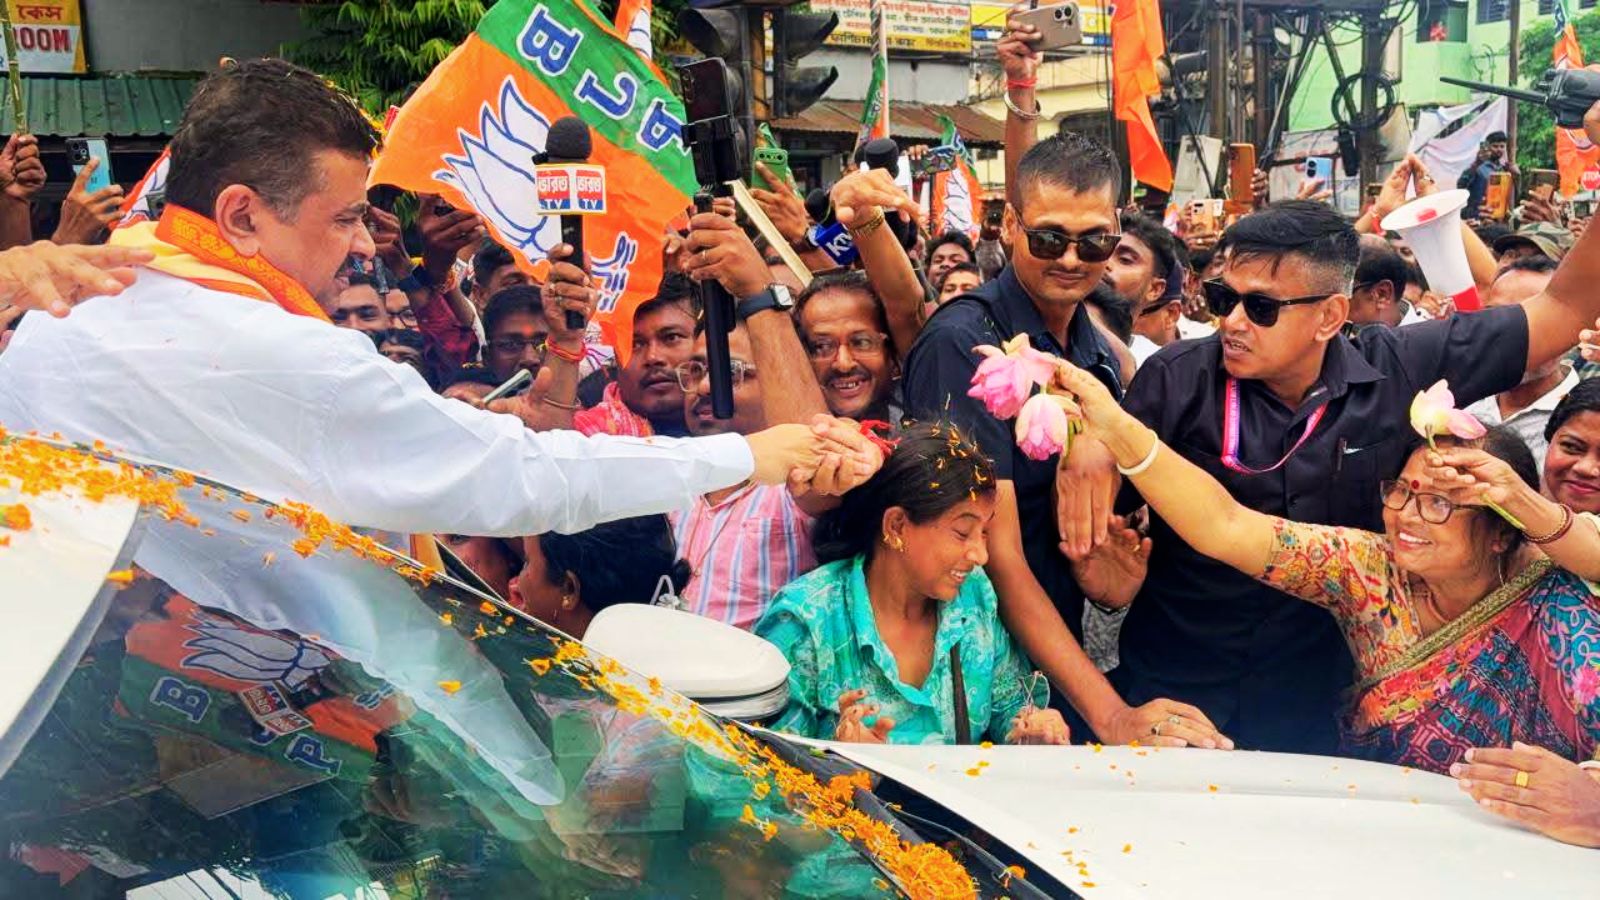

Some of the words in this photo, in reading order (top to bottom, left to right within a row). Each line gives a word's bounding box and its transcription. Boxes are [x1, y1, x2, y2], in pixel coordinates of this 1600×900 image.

[538, 176, 568, 193] ভারত
[544, 199, 563, 210] TV
[582, 199, 598, 210] TV
